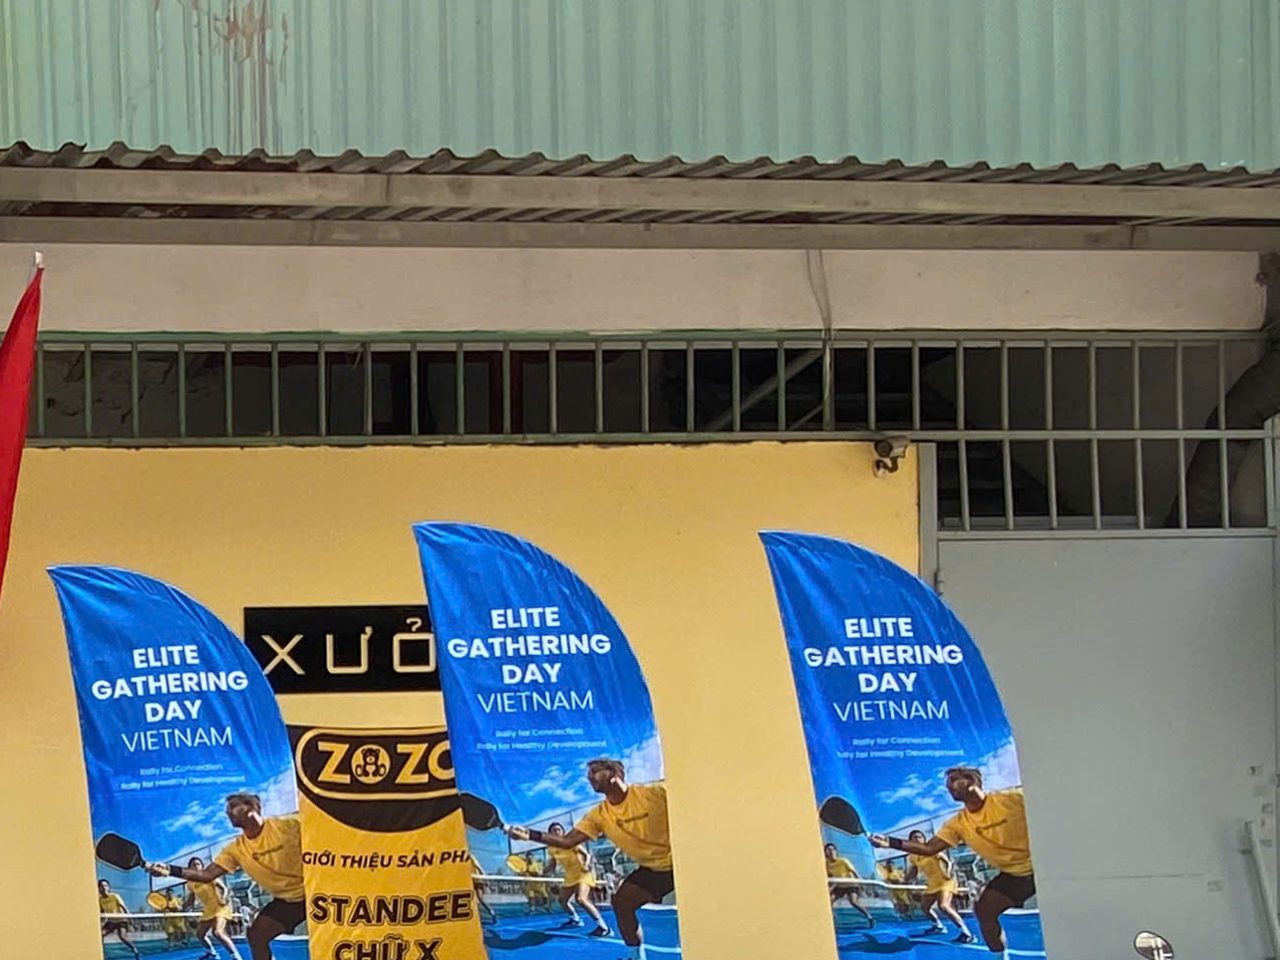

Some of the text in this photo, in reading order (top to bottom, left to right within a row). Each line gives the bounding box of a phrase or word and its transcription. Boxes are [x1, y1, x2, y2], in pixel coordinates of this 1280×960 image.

[491, 607, 560, 629] ELITE
[844, 618, 914, 638] ELITE
[132, 645, 200, 668] ELITE
[261, 617, 436, 675] XƯỞ
[448, 634, 611, 658] GATHERING
[804, 644, 963, 667] GATHERING
[502, 663, 562, 684] DAY
[858, 672, 917, 693] DAY
[92, 671, 248, 700] GATHERING
[145, 700, 202, 722] DAY
[477, 690, 594, 713] VIETNAM
[833, 700, 949, 722] VIETNAM
[121, 726, 232, 752] VIETNAM
[302, 849, 470, 872] GIỚI THIỆU SẢN PH
[310, 891, 474, 926] STANDEE
